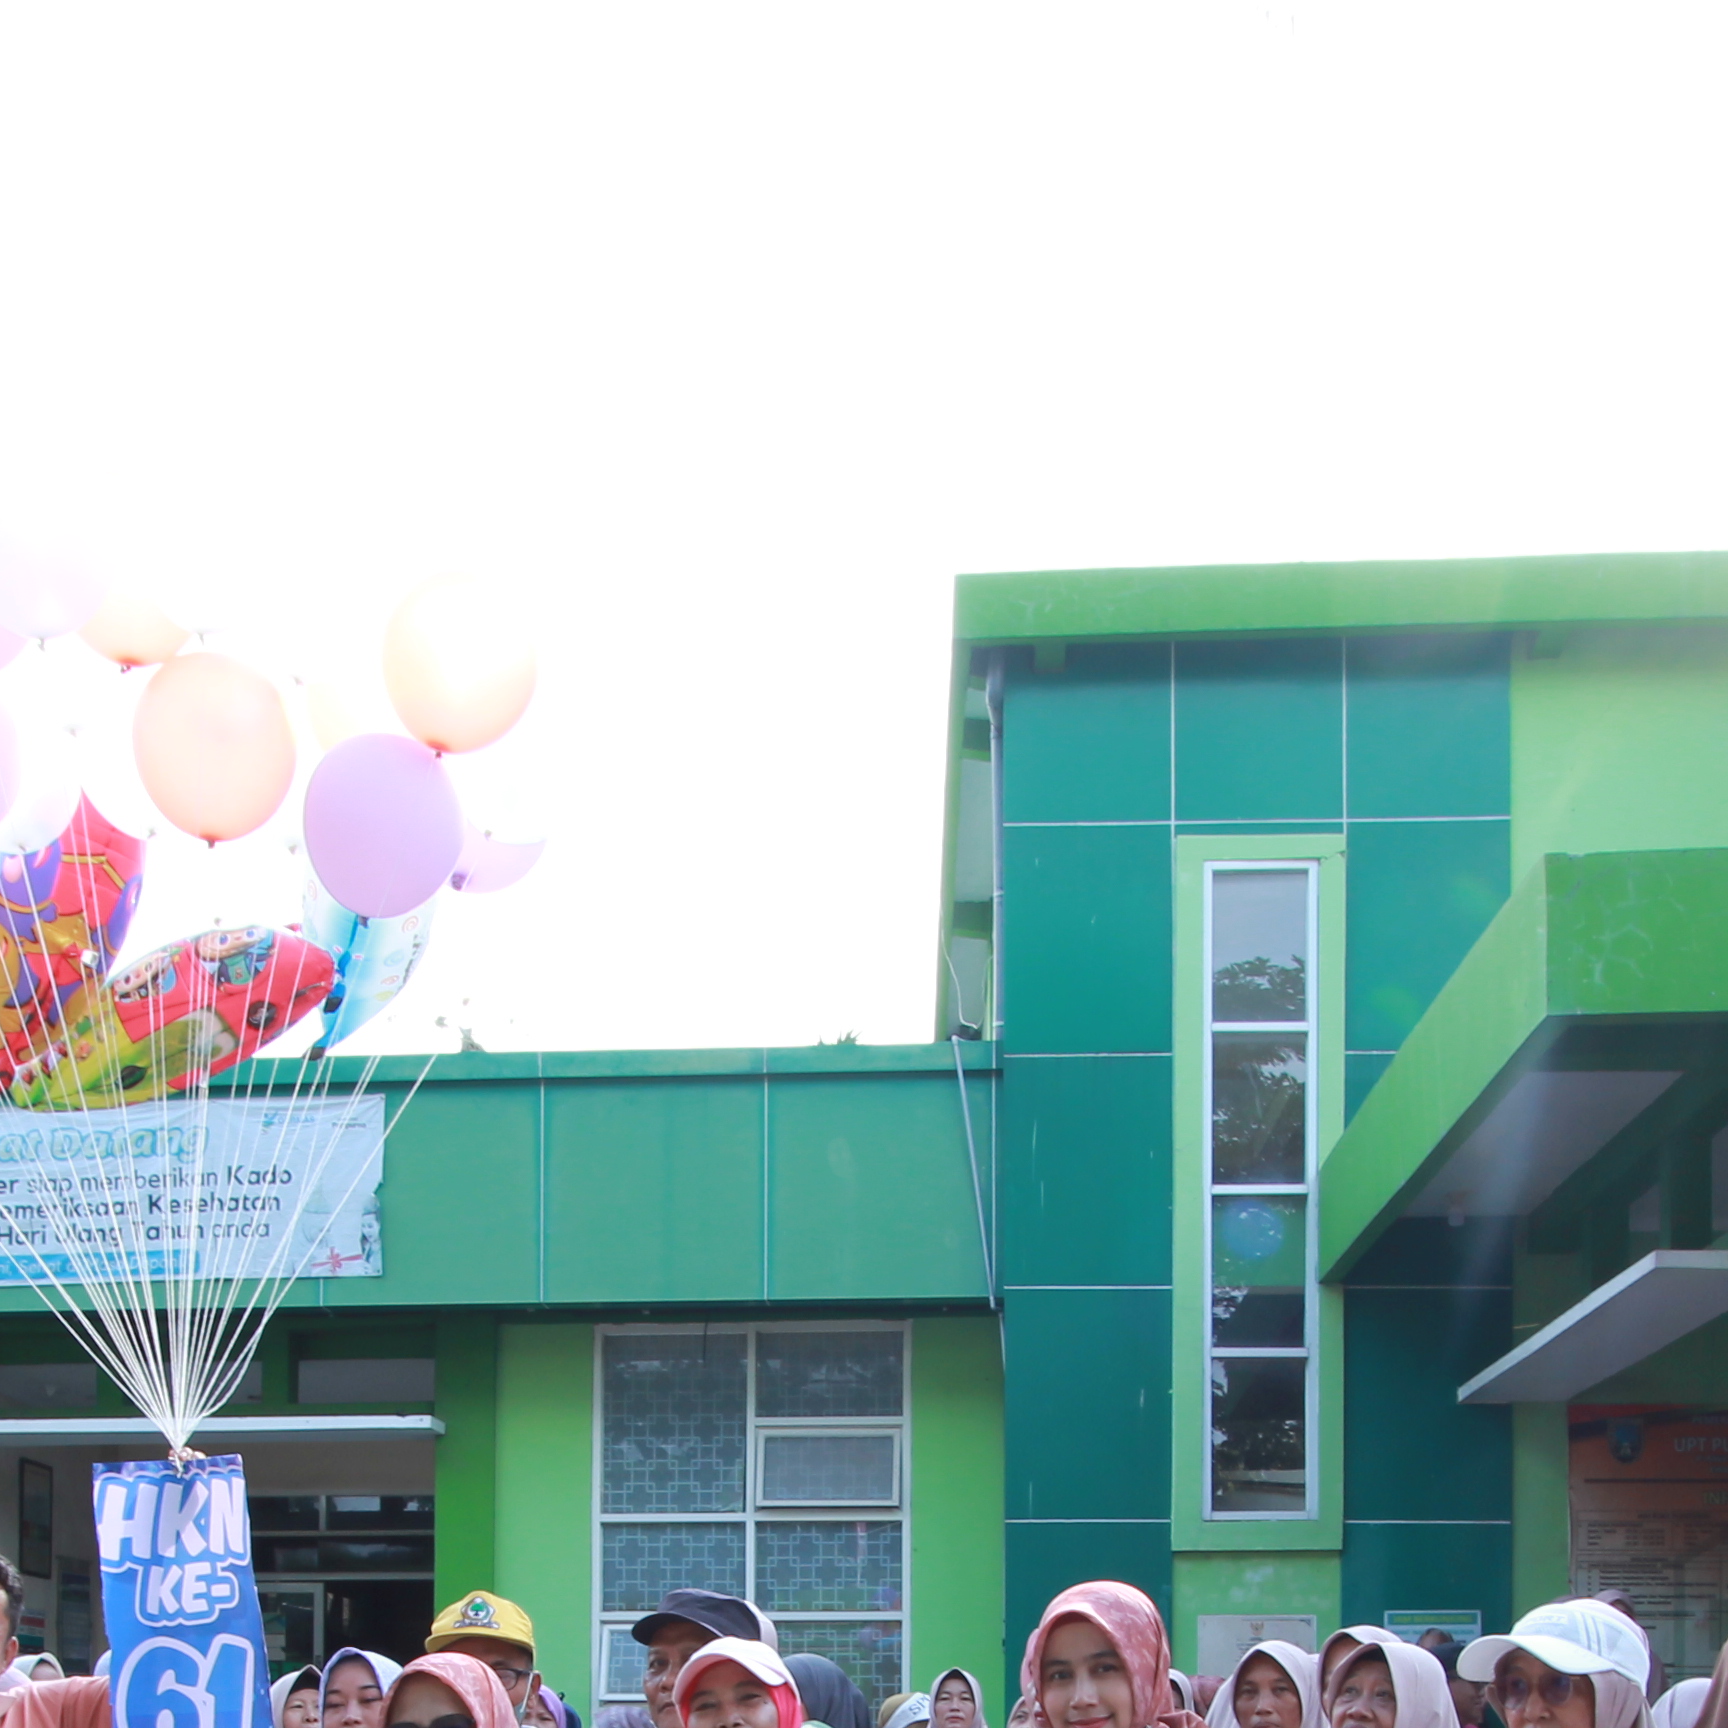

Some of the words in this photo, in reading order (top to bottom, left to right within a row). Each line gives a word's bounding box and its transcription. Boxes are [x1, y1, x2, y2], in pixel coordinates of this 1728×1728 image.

[50, 1126, 210, 1164] Datang
[26, 1175, 73, 1195] siap
[80, 1170, 219, 1192] memberikan
[227, 1164, 293, 1186] Kado
[148, 1191, 281, 1215] Kesehatan
[133, 1219, 205, 1242] Tahun
[212, 1218, 270, 1239] anda
[1674, 1437, 1706, 1452] UPT
[99, 1476, 247, 1563] HKN
[145, 1560, 232, 1616] KE-
